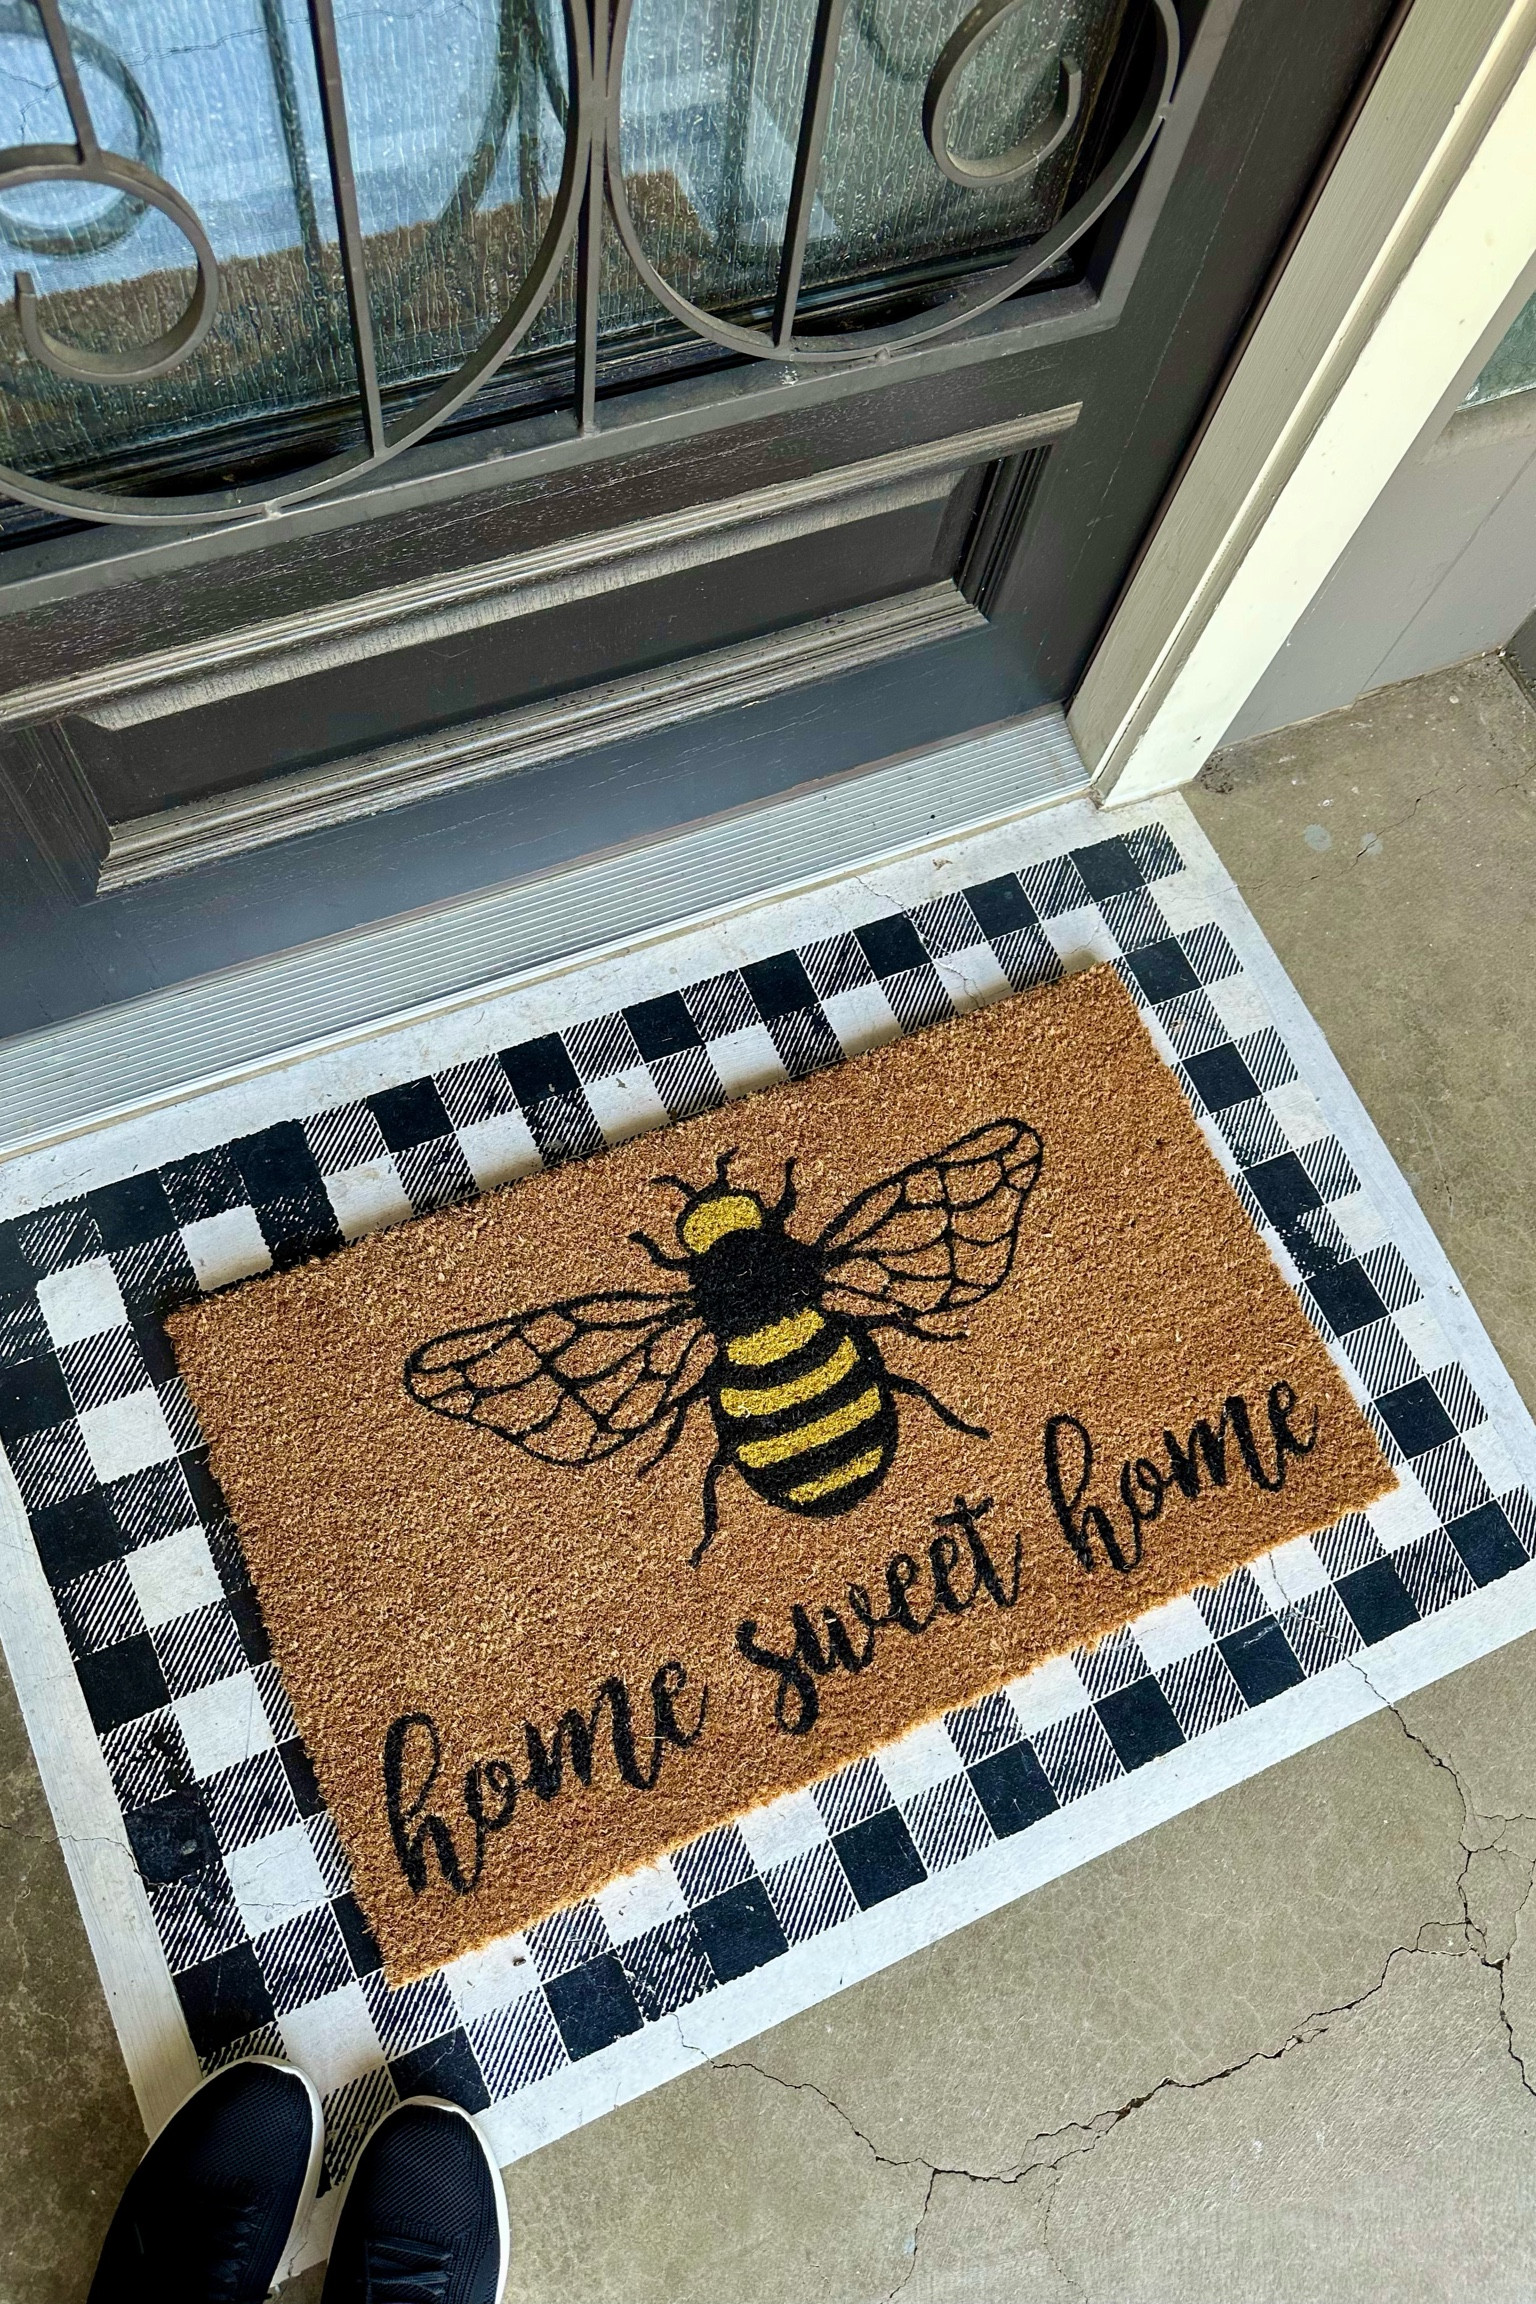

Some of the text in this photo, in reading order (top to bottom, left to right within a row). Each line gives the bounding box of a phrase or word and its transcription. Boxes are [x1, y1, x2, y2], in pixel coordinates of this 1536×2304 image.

[383, 1379, 1319, 1895] home sweet home
